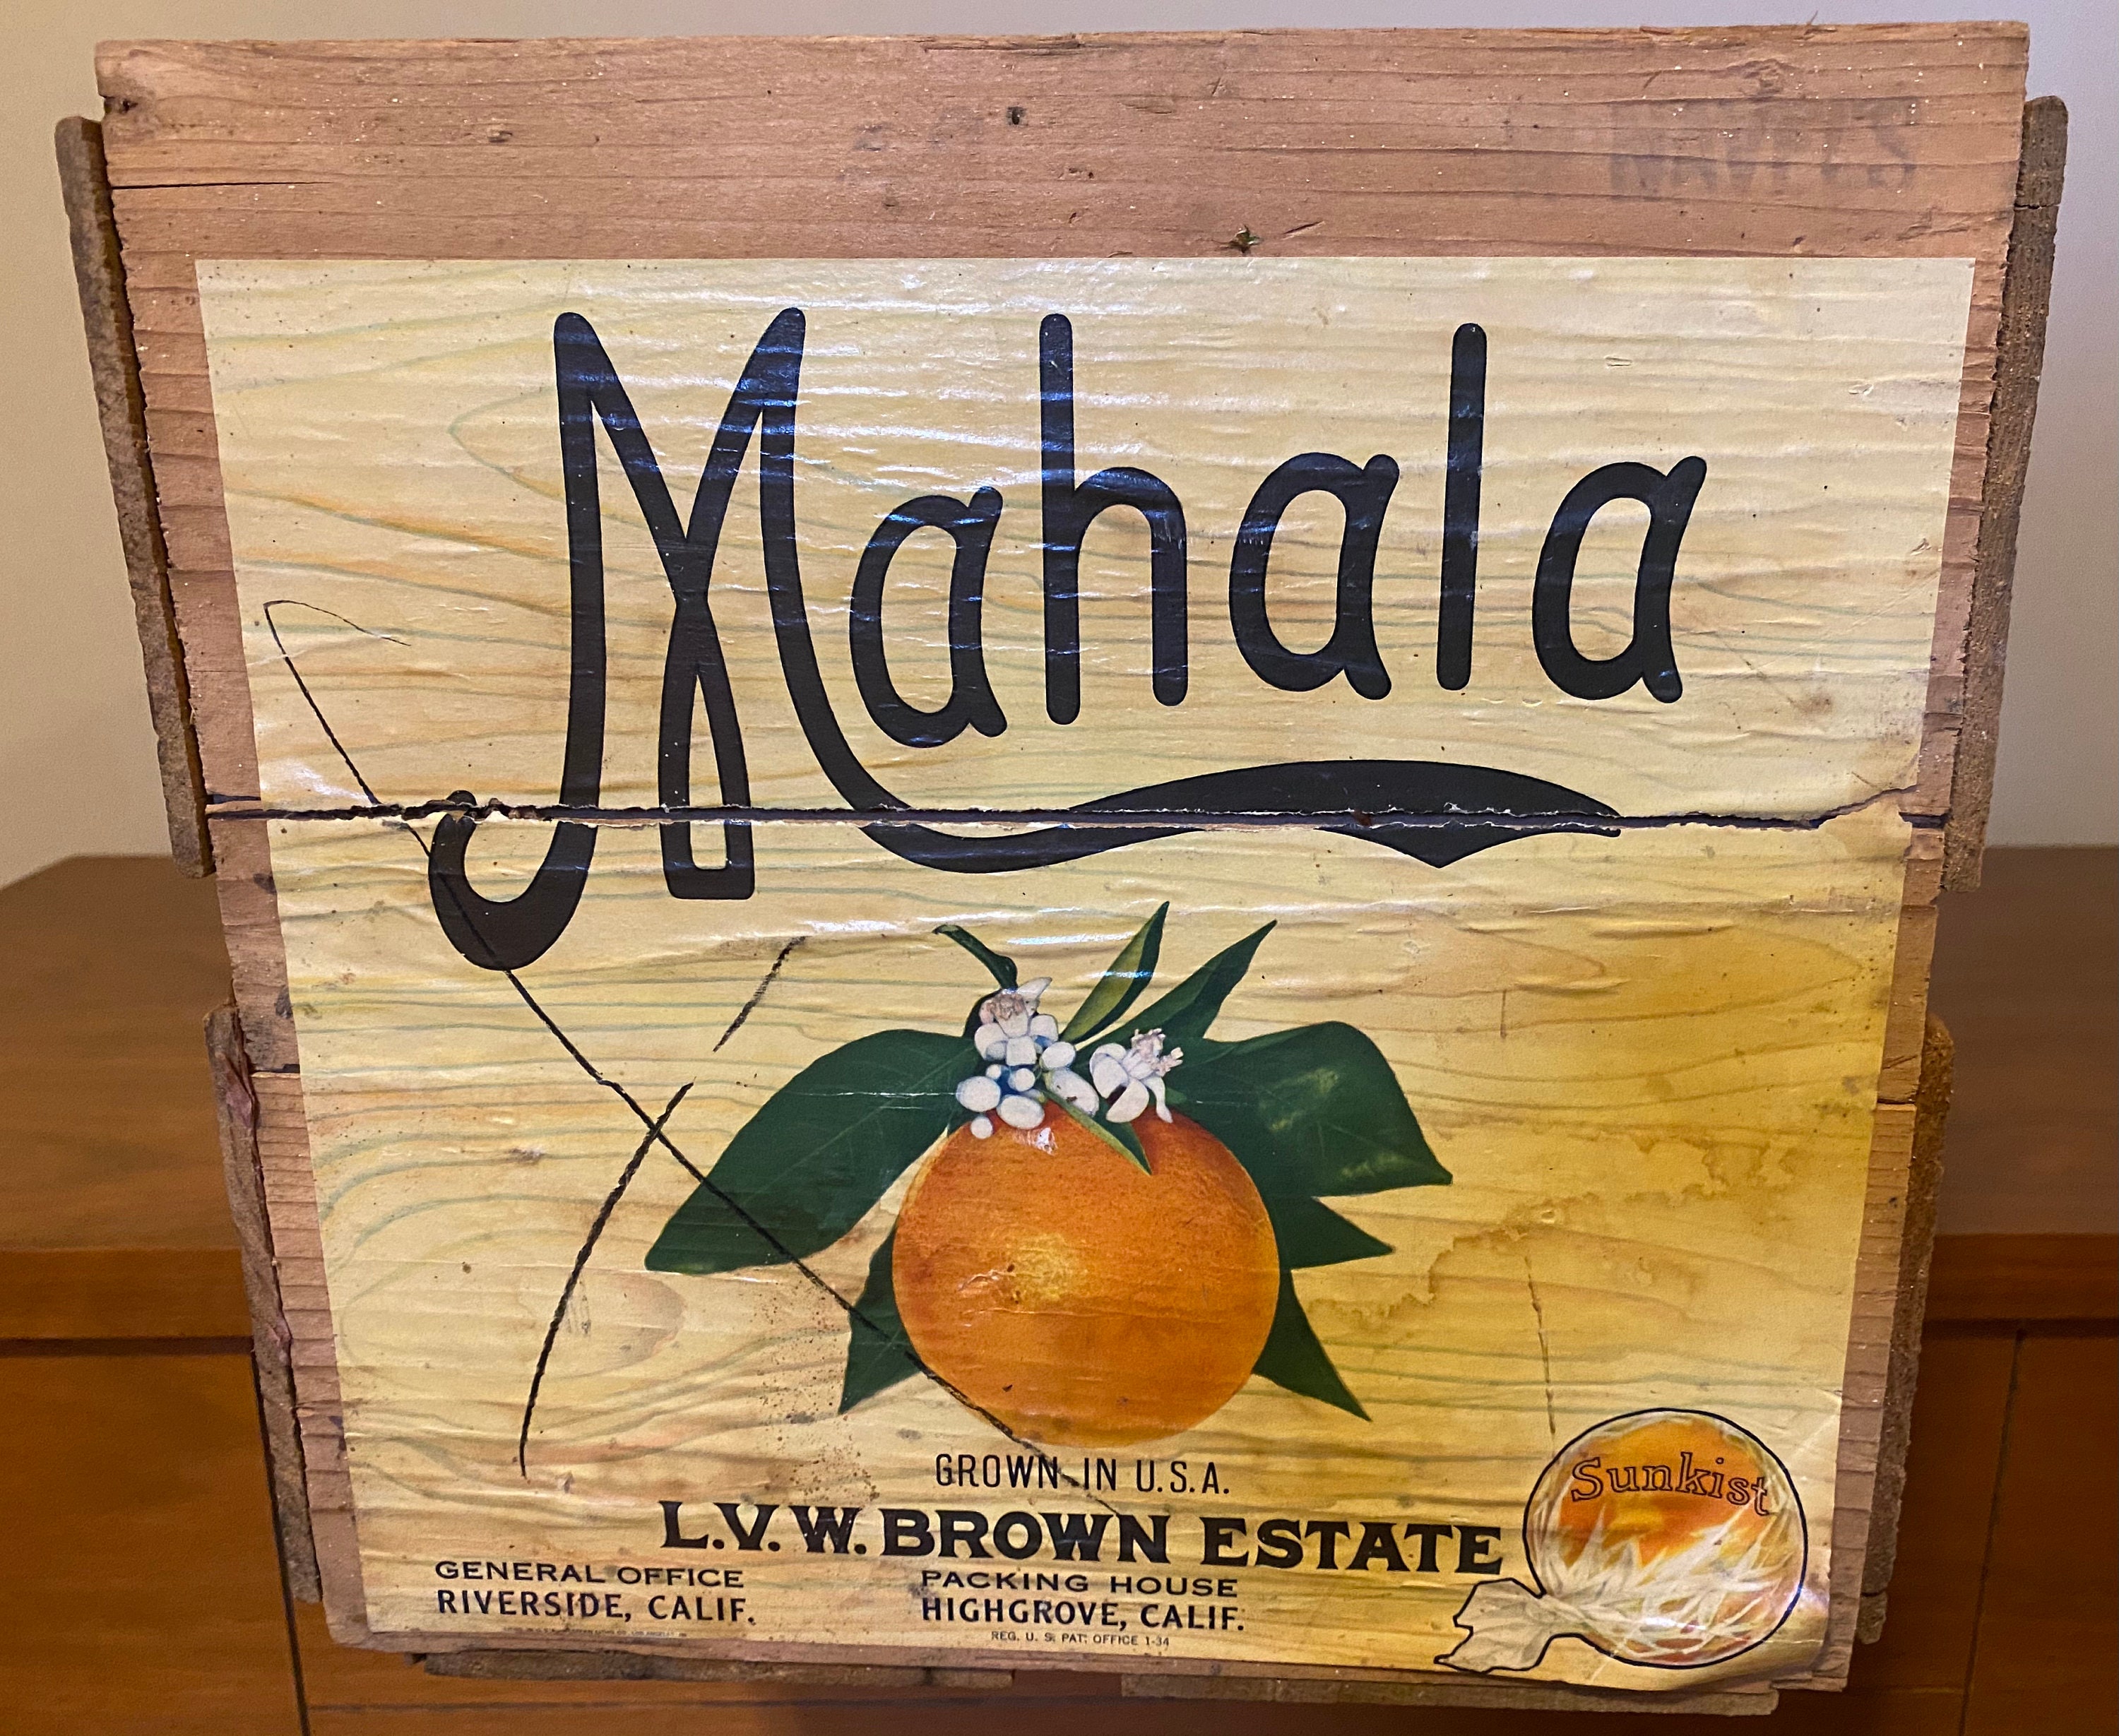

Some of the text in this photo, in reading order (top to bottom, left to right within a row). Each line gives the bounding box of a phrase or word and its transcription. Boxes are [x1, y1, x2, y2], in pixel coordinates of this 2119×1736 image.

[428, 307, 1707, 970] Mahala
[934, 1453, 1231, 1494] GROWN IN U.S.A.
[1571, 1451, 1770, 1516] Sunkist
[877, 1508, 1172, 1565] BROWN
[1199, 1516, 1504, 1576] ESTATE
[434, 1560, 745, 1588] GENERAL OFFICE
[920, 1570, 1239, 1598] PACKING HOUSE
[437, 1589, 757, 1625] RIVERSIDE, CALIF.
[921, 1598, 1245, 1631] HIGHGROVE, CALIF.
[990, 1630, 1021, 1642] REG.
[1092, 1634, 1139, 1646] OFFICE
[1144, 1636, 1170, 1647] 1-34
